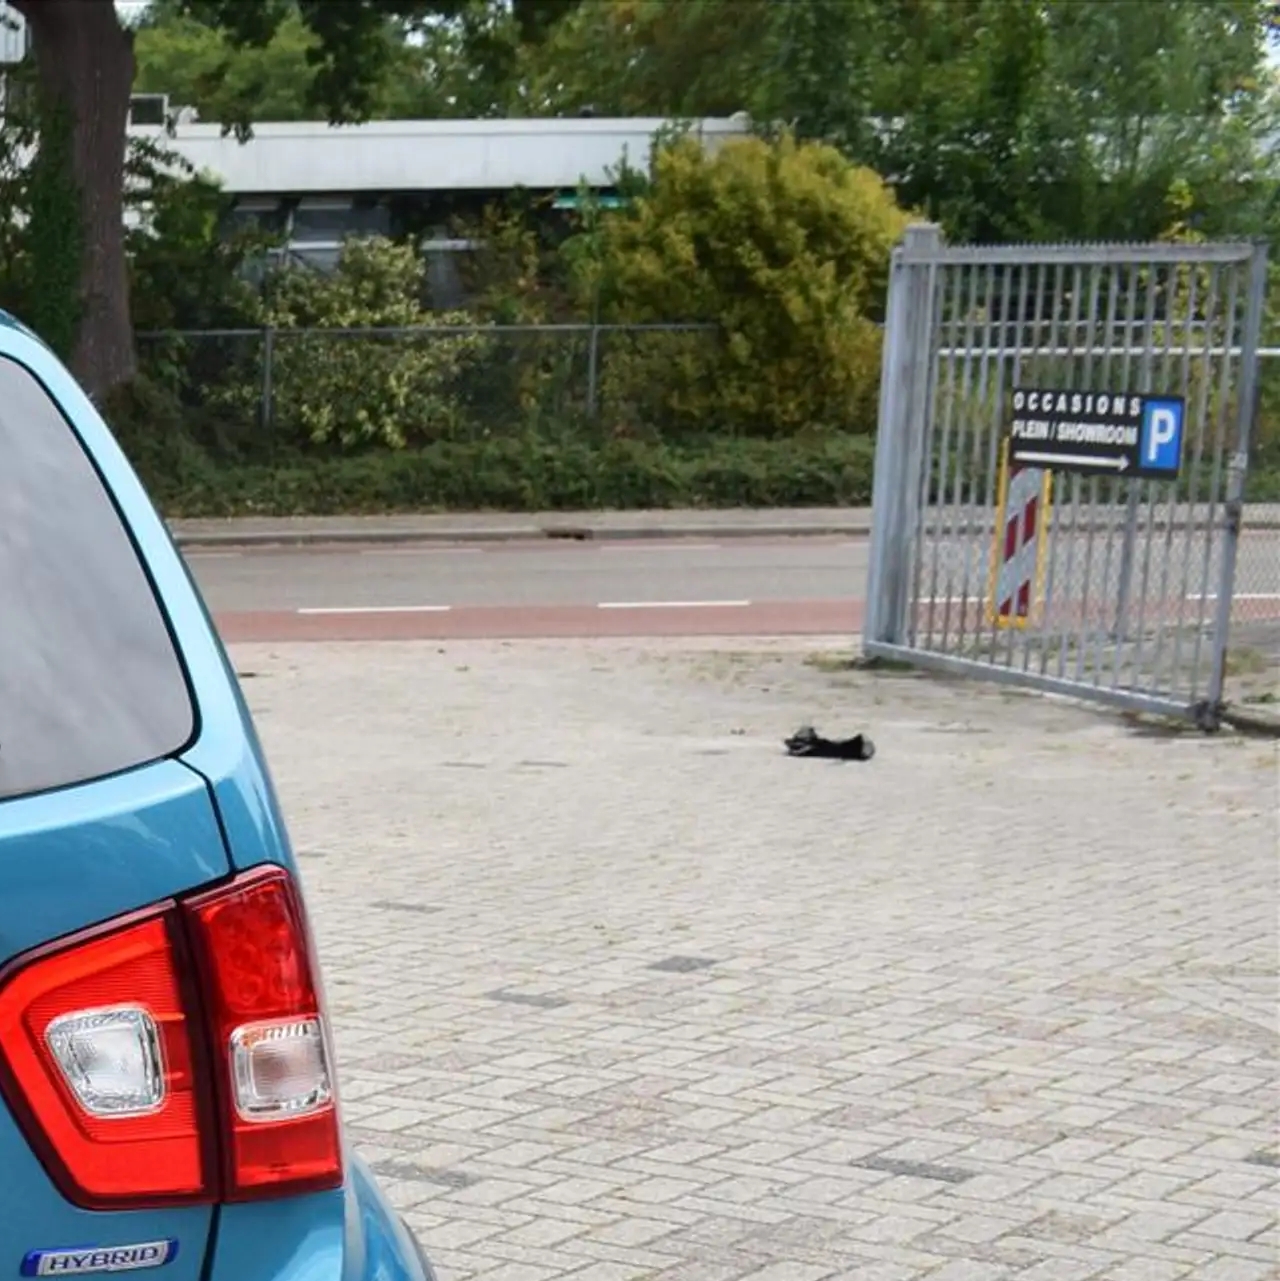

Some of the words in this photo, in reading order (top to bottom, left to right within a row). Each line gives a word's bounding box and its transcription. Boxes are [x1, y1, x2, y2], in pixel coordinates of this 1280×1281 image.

[1013, 391, 1141, 417] OCCASIONS
[1148, 408, 1176, 461] P
[49, 1247, 158, 1271] HYBRID
